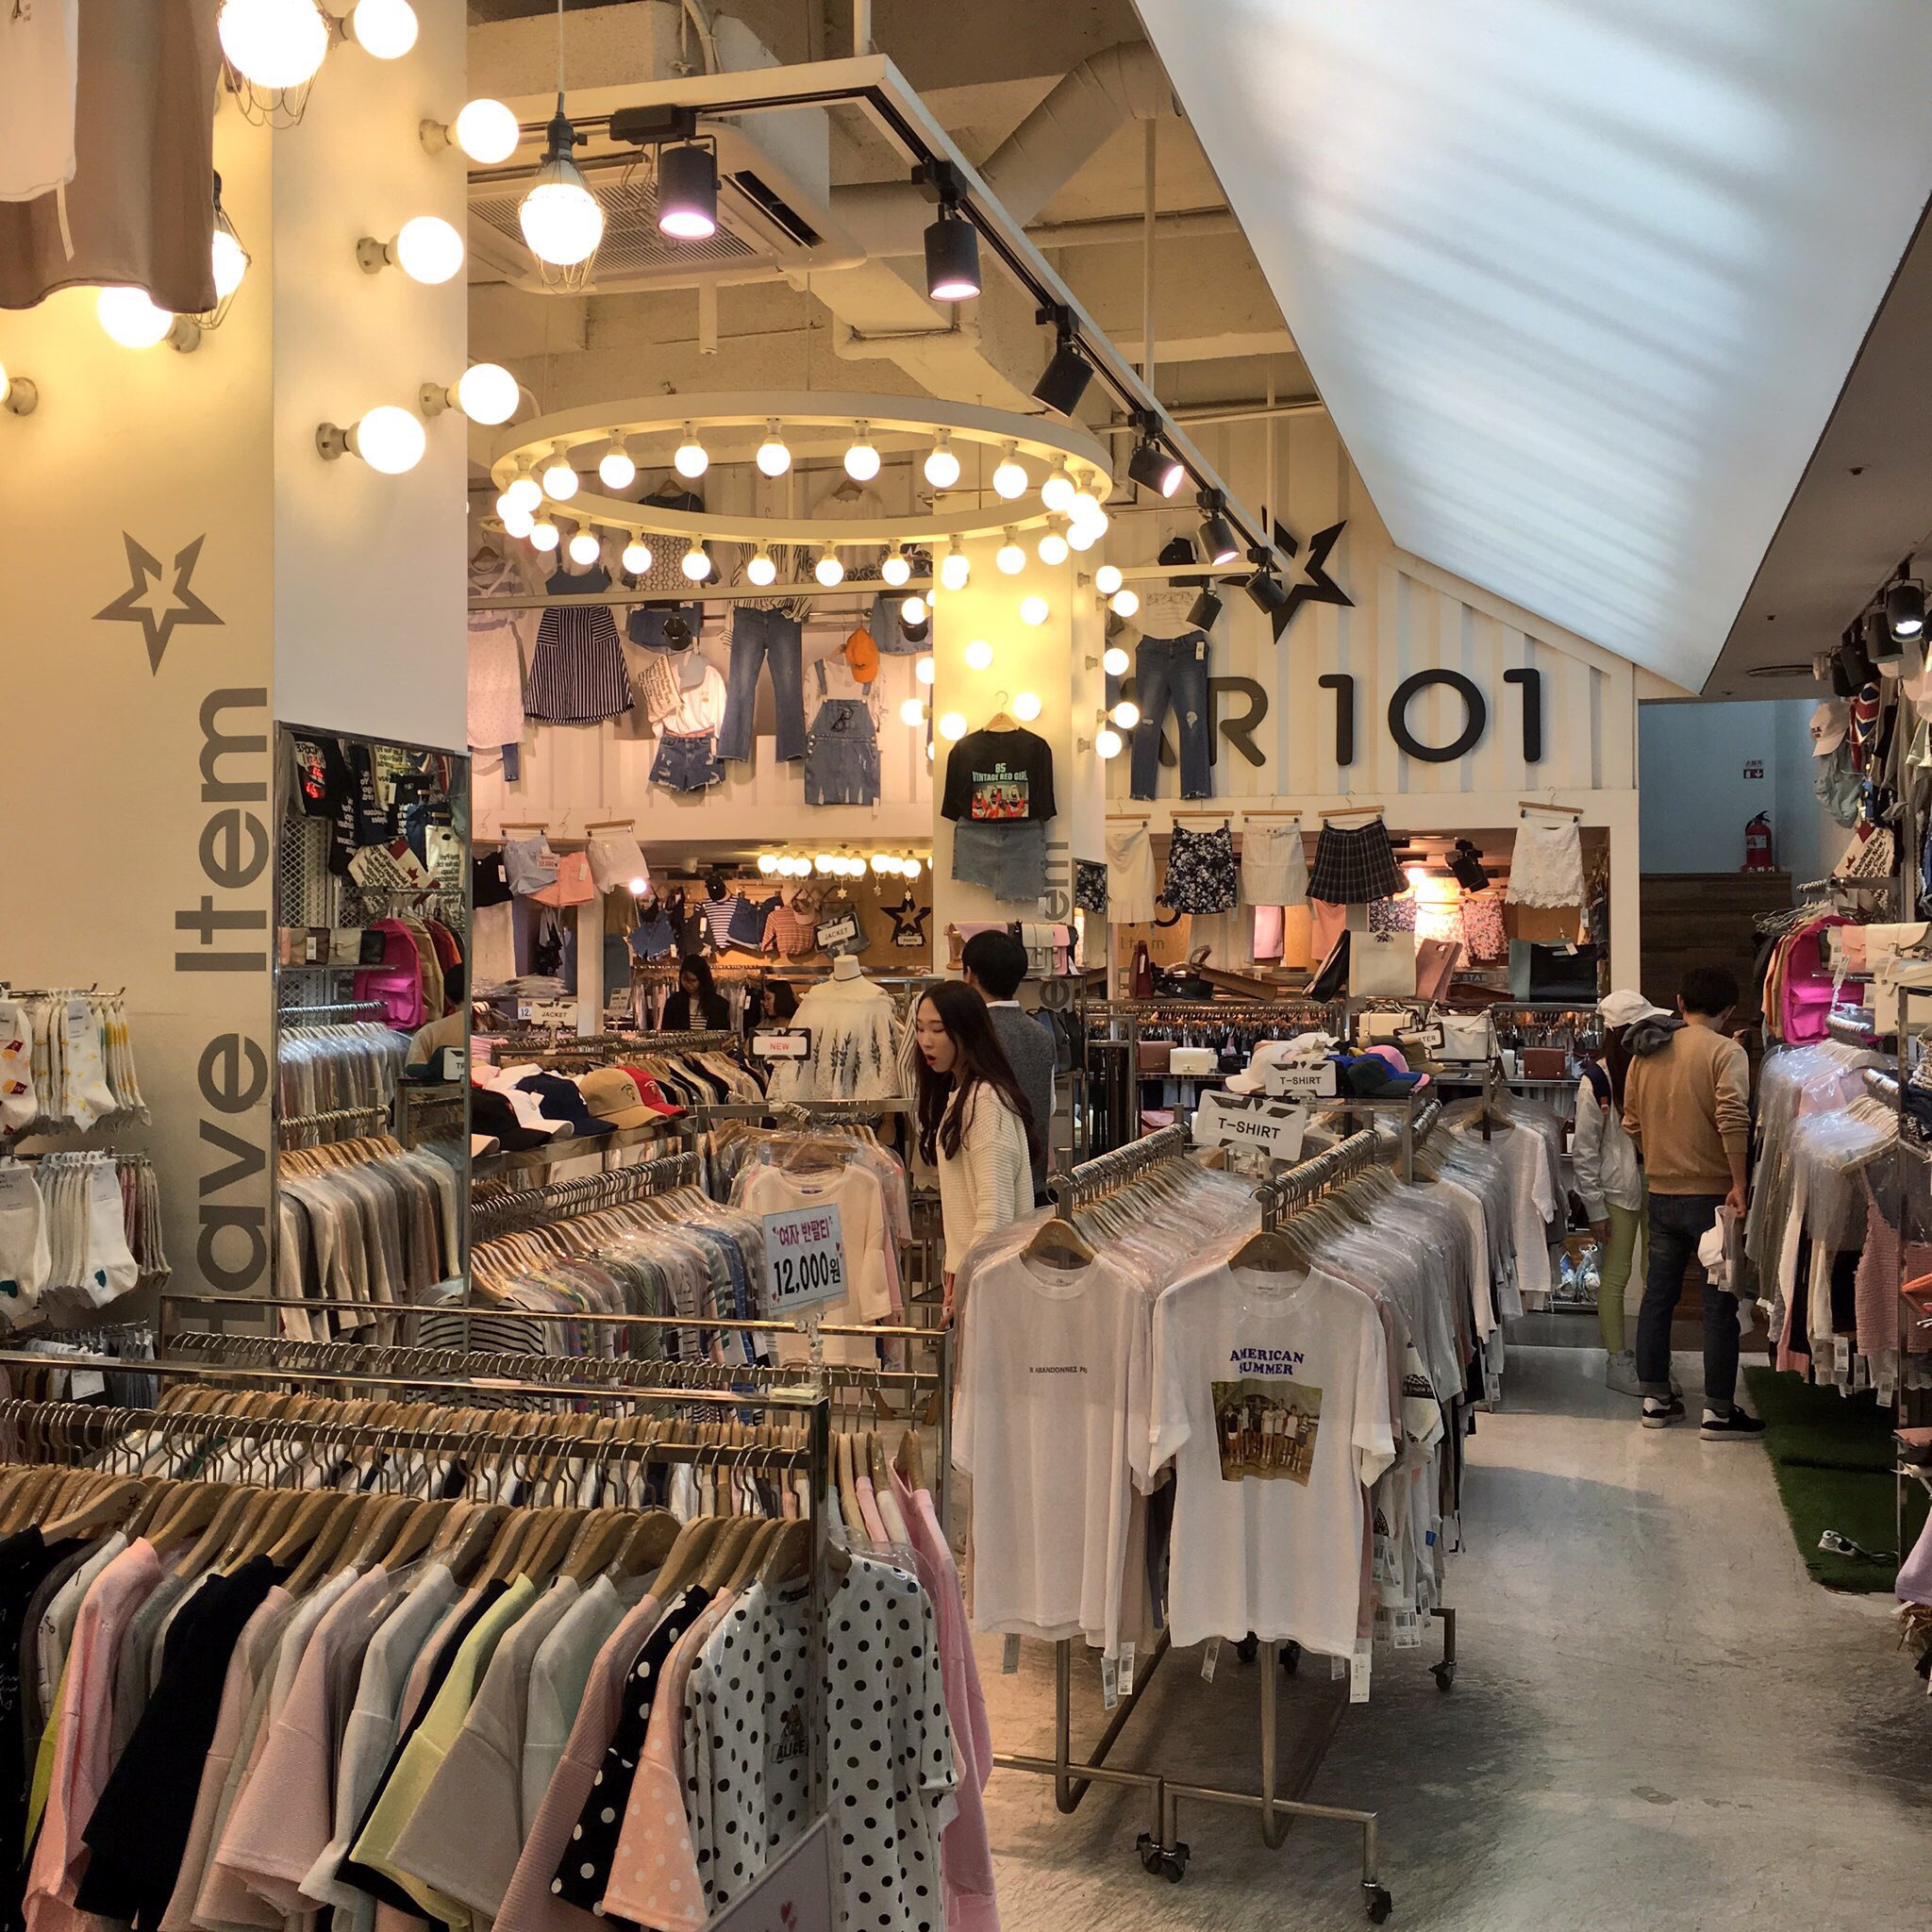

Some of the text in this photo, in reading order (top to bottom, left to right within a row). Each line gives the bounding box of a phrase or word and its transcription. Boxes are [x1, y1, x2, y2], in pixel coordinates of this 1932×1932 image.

[1319, 668, 1541, 766] 101
[972, 770, 1028, 782] VINTAGE RED GIRL
[994, 762, 1007, 774] 85
[175, 688, 269, 972] Item
[1851, 845, 1874, 875] Montreal
[824, 927, 849, 941] JACKET
[1120, 936, 1165, 950] Itm
[1279, 1075, 1322, 1086] T-SHIRT
[1218, 1117, 1281, 1140] T-SHIRT
[779, 1219, 830, 1245] 여자 반팔티
[774, 1251, 841, 1296] 12,000원
[1229, 1347, 1305, 1375] AMERICAN SUMMER
[776, 1740, 806, 1760] ALICE
